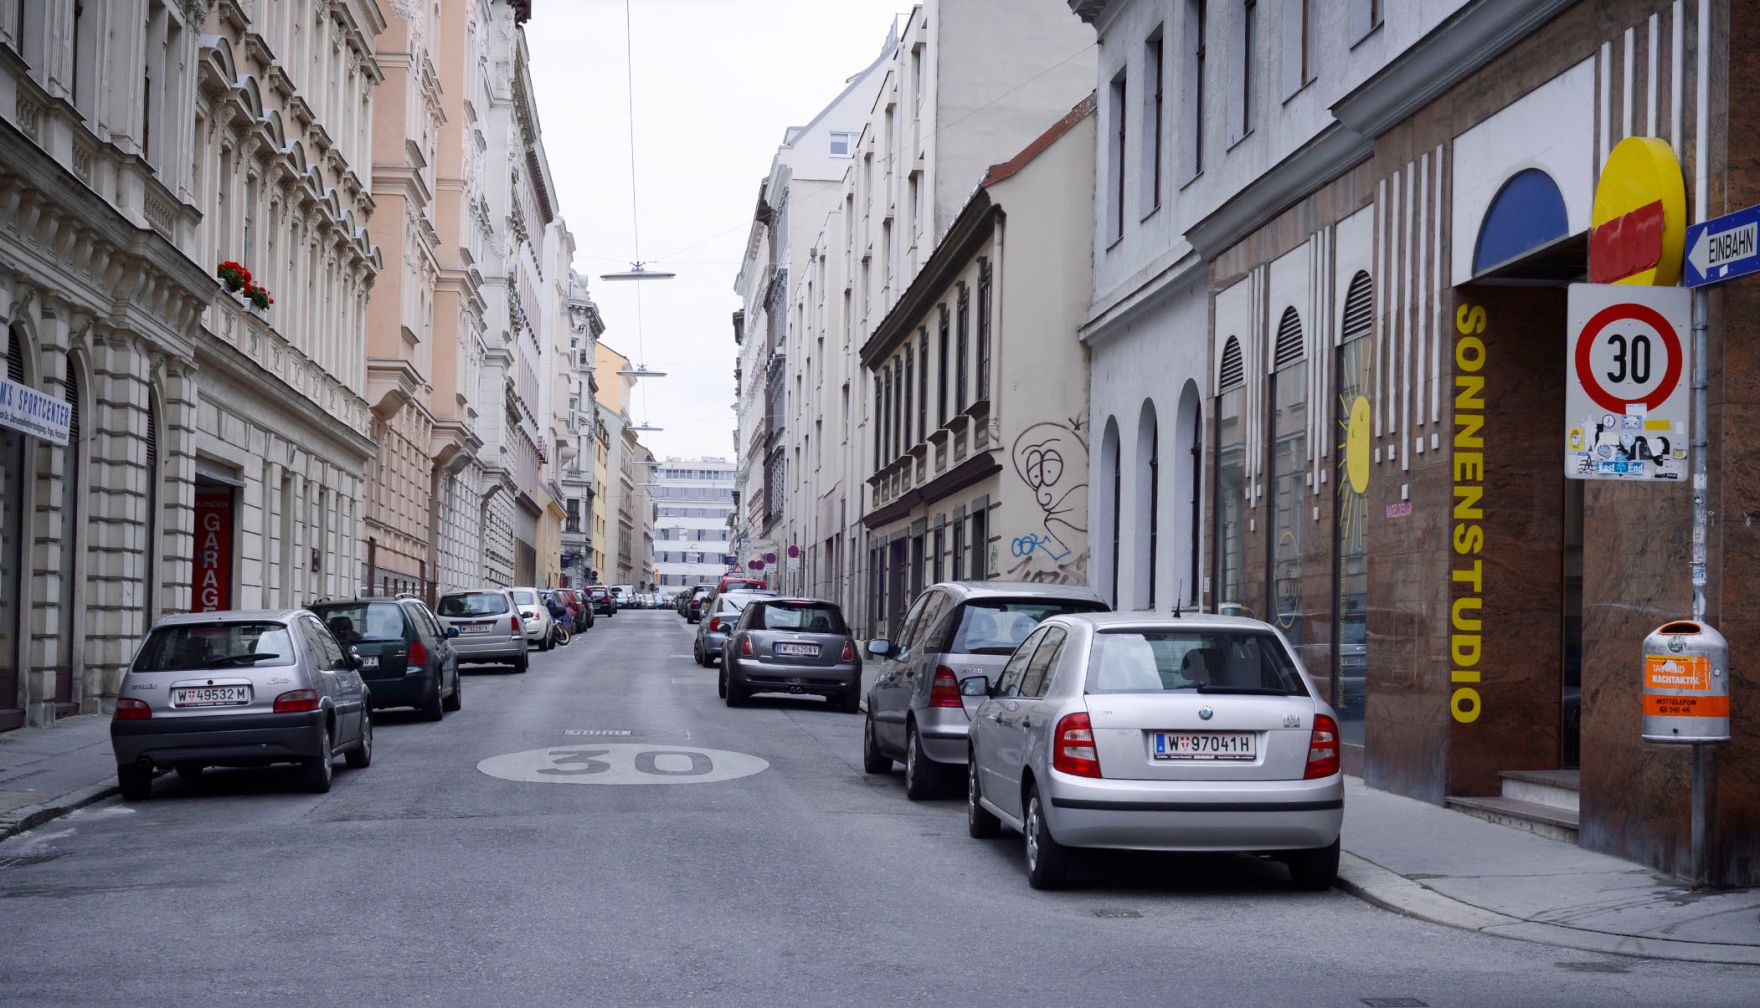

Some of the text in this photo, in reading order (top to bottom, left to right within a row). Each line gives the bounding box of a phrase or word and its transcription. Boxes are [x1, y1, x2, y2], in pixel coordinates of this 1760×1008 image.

[1709, 226, 1754, 264] EINBAHN
[1607, 333, 1652, 385] 30
[18, 389, 69, 428] SPORTCENTER
[1450, 302, 1488, 724] SONNENSTUDIO
[178, 691, 187, 701] W
[197, 689, 234, 701] 49532
[536, 750, 713, 776] 30
[1168, 736, 1249, 752] W 97041H
